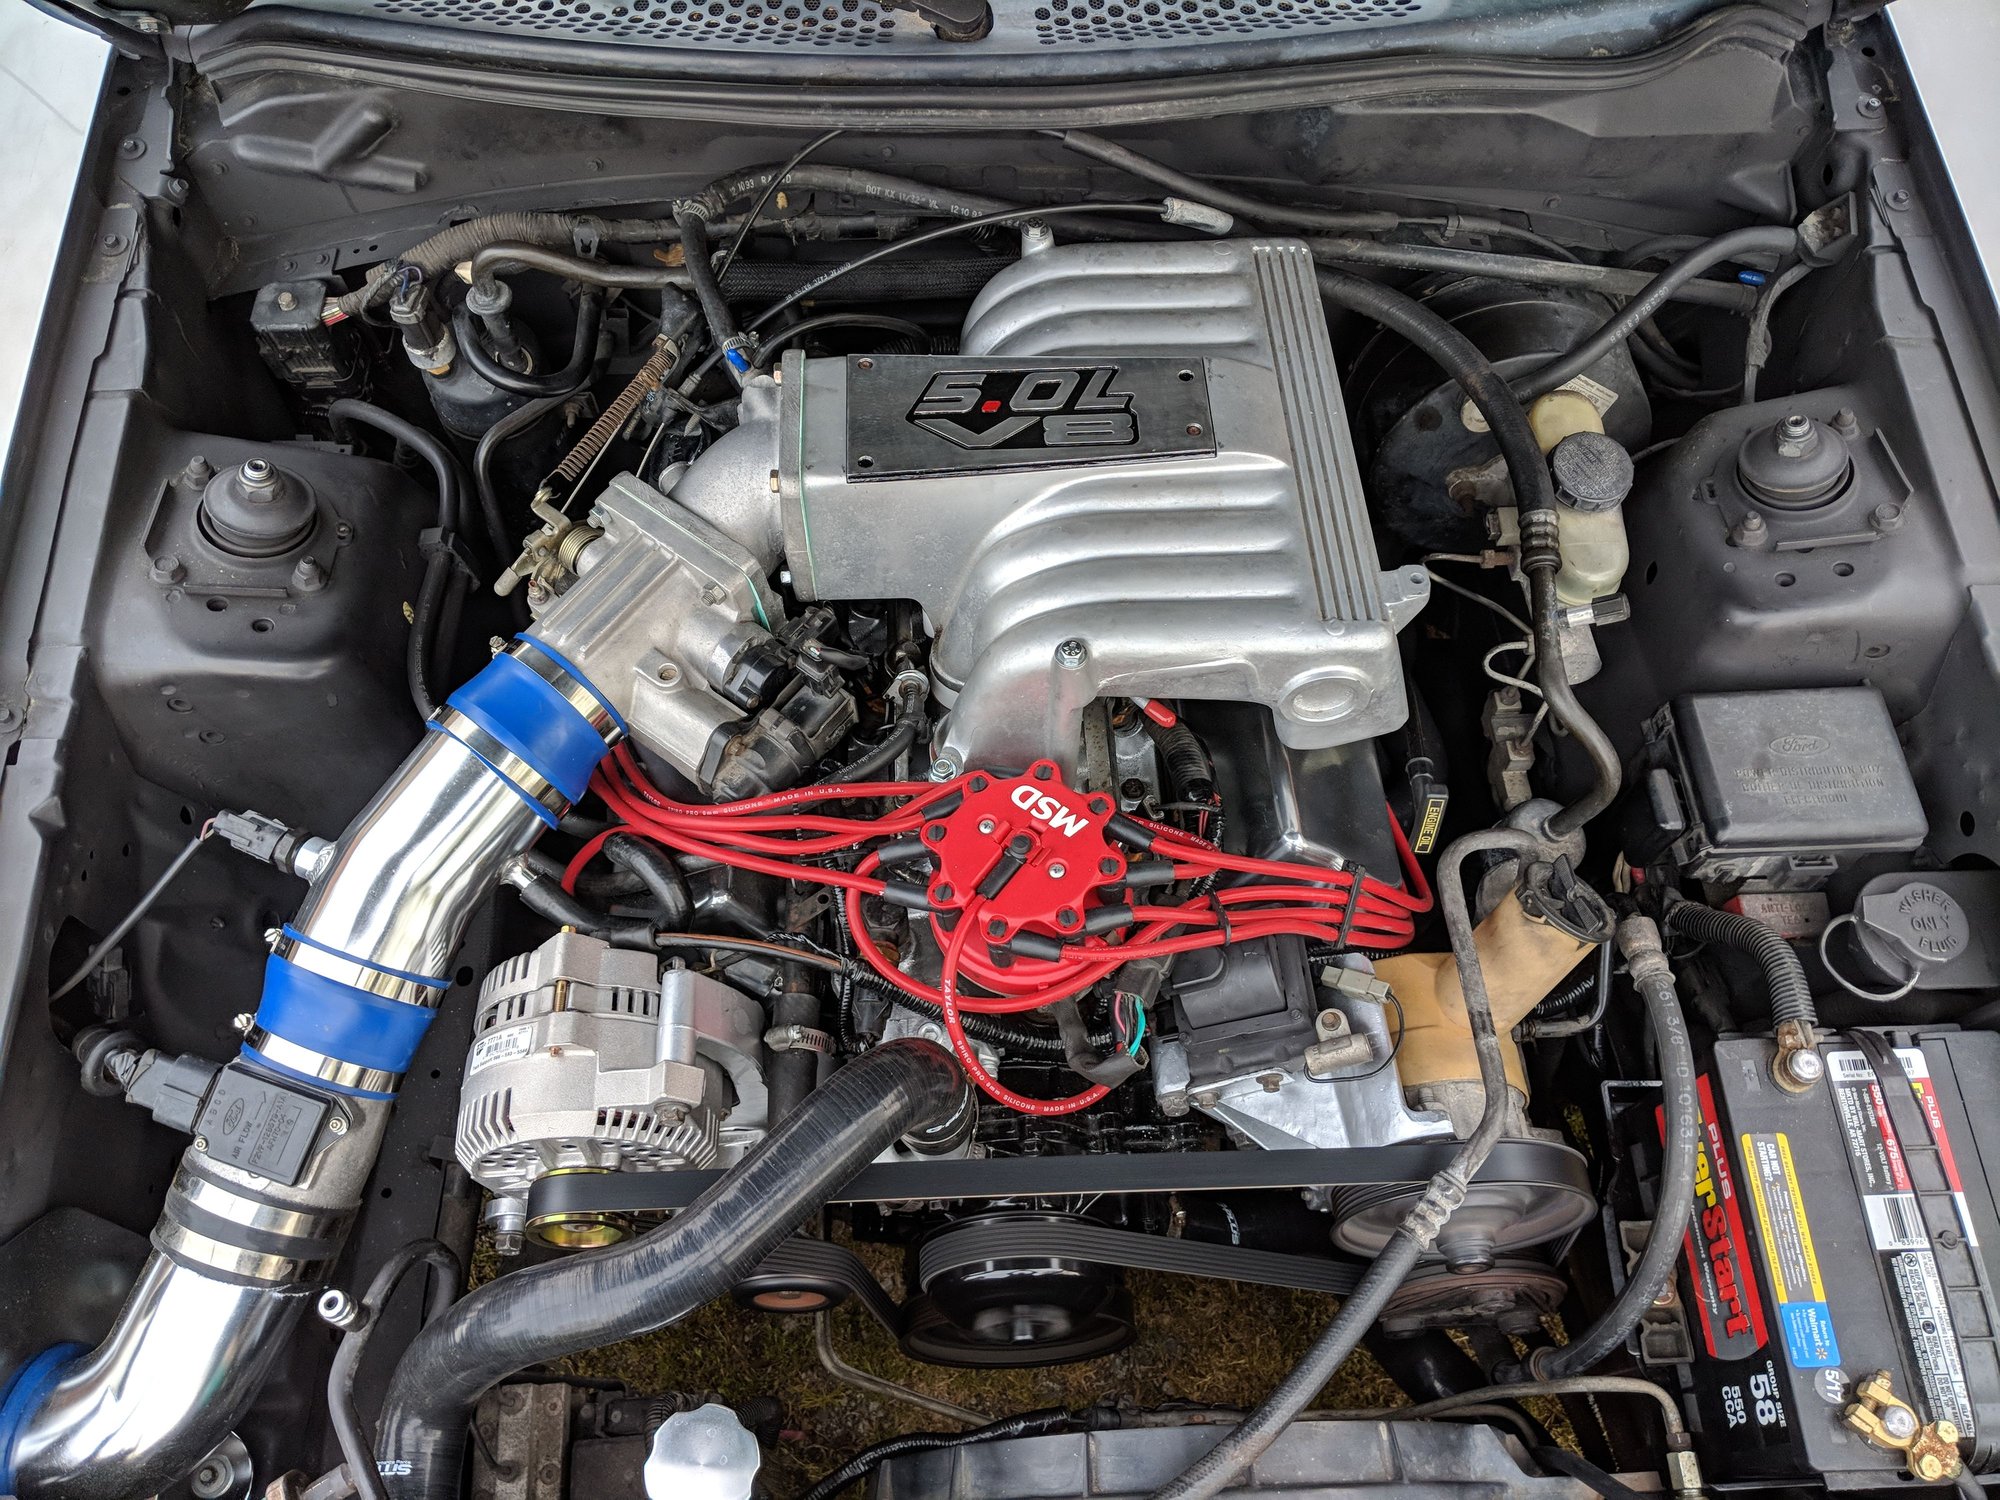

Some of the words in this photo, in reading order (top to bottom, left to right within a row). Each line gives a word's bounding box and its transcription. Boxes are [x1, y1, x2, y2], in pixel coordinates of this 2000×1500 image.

[866, 184, 881, 195] DOT
[914, 370, 1129, 415] 5.0L
[914, 413, 1134, 449] V8
[1782, 736, 1817, 752] Ford
[723, 801, 764, 813] SILICONE
[773, 793, 800, 803] MADE
[819, 787, 845, 795] U.S.A.
[1011, 784, 1089, 837] MSD
[1149, 823, 1184, 837] SILICONE
[1423, 807, 1440, 834] ENGINE
[1419, 836, 1431, 846] OIL
[1900, 889, 1951, 915] WASHER
[1911, 915, 1950, 930] ONLY
[1920, 936, 1957, 953] FLUID
[944, 979, 956, 1024] TAYLOR
[957, 1040, 972, 1064] SPIRO
[972, 1066, 985, 1081] PRO
[986, 1081, 1001, 1095] 8mm
[1003, 1095, 1035, 1111] SILICONE
[1079, 1091, 1100, 1105] U.S.A.
[1871, 1083, 1883, 1105] 550
[1849, 1105, 1856, 1114] BY
[1925, 1095, 1941, 1129] PLUS
[232, 1146, 242, 1159] AIR
[238, 1121, 252, 1144] FLOW
[1849, 1128, 1856, 1138] AR
[1851, 1114, 1865, 1147] WAL-MART
[1708, 1123, 1731, 1199] PLUS
[1755, 1140, 1773, 1182] STARTING?
[1765, 1142, 1777, 1161] CAR
[1859, 1146, 1871, 1172] STORES,
[1876, 1142, 1887, 1164] 12-VOLT
[1885, 1137, 1898, 1160] 675
[1770, 1161, 1781, 1176] NOT
[1881, 1164, 1892, 1185] Battery
[1783, 1162, 1793, 1184] BATTERY
[1789, 1186, 1798, 1205] TESTING
[1695, 1106, 1751, 1338] erStart
[1703, 1261, 1719, 1314] Warranty
[1907, 1268, 1916, 1284] REACH
[1914, 1291, 1924, 1315] CHILDREN
[1806, 1307, 1823, 1347] Walmart
[1819, 1319, 1829, 1339] Return
[1931, 1335, 1939, 1348] READ
[1825, 1369, 1841, 1402] 5/17
[1936, 1376, 1943, 1385] DO
[1942, 1376, 1949, 1384] DO
[1944, 1384, 1952, 1396] NOT
[1732, 1386, 1747, 1424] 550
[1750, 1374, 1776, 1426] 58
[1766, 1360, 1780, 1399] GROUP
[1776, 1402, 1787, 1427] SIZE
[1947, 1396, 1956, 1410] OPEN
[1722, 1386, 1738, 1428] CCA
[1960, 1402, 1970, 1419] HELP
